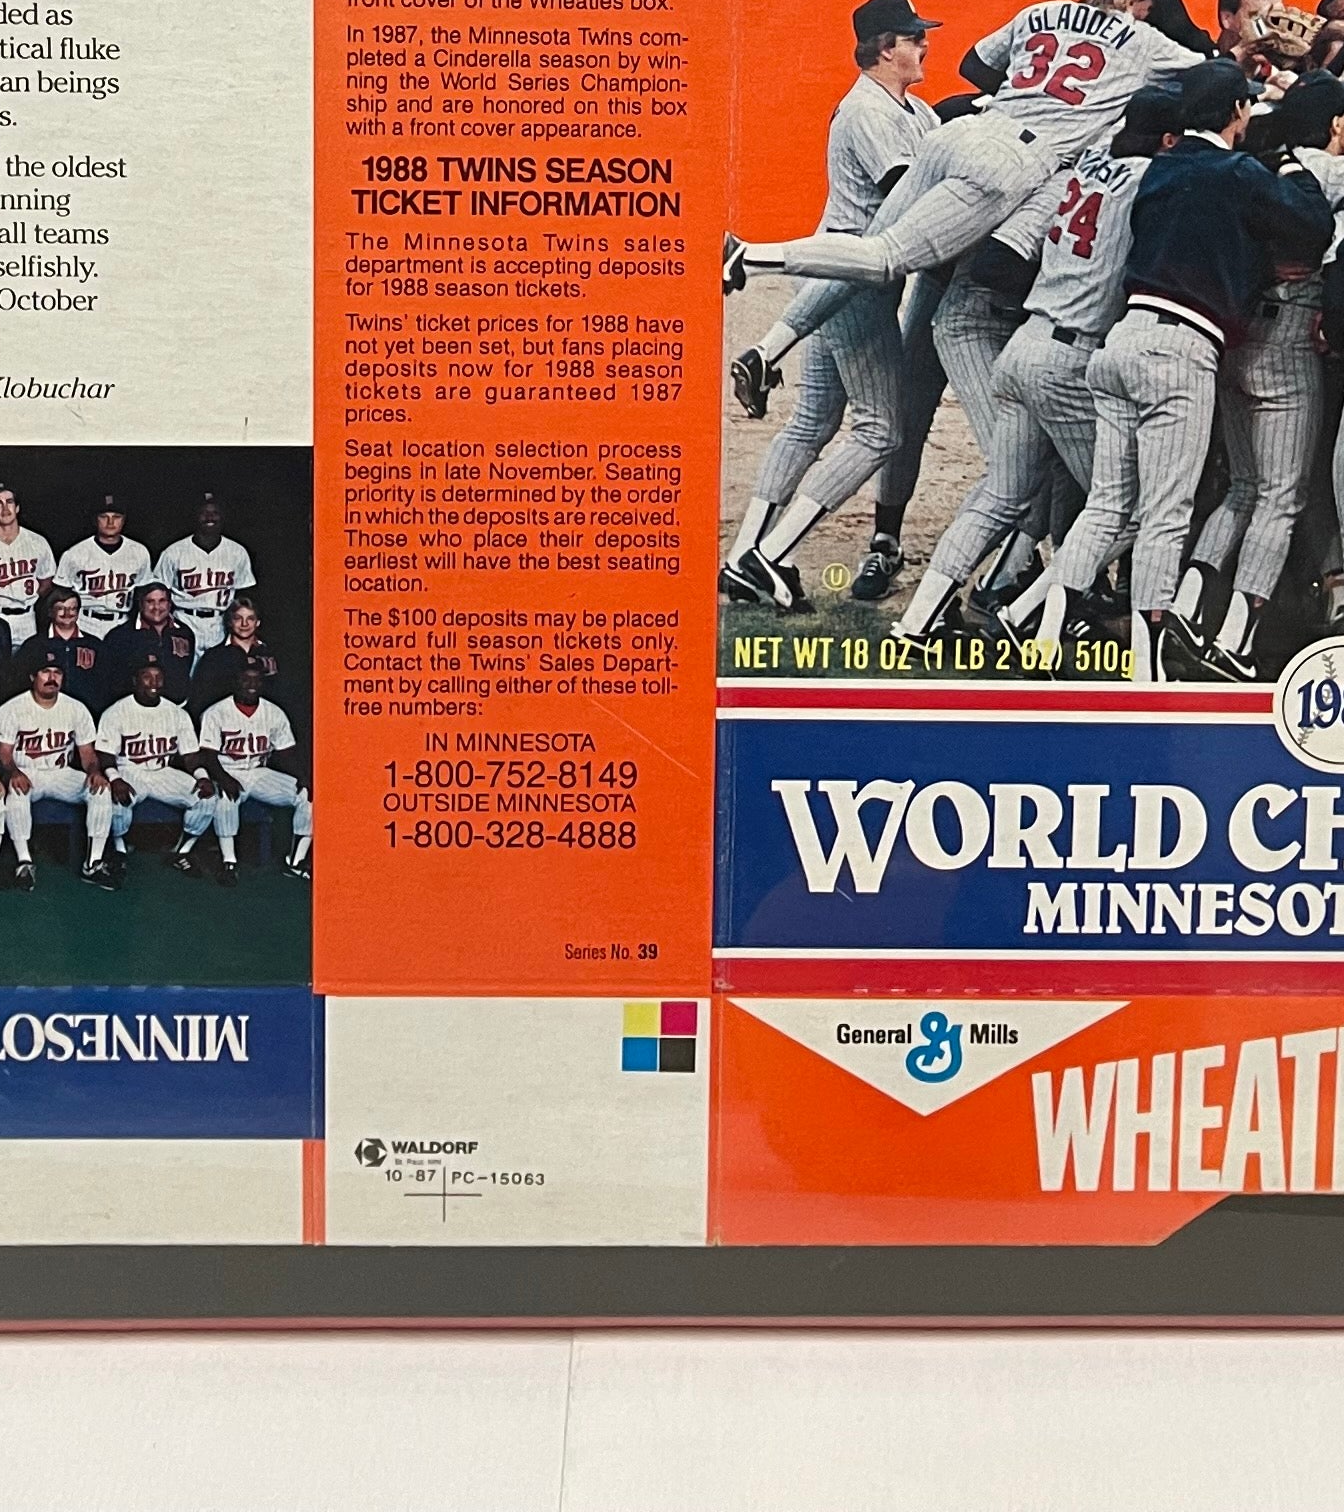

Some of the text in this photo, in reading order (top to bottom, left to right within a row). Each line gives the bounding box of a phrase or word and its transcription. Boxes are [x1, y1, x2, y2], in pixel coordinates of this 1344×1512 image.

[1028, 3, 1136, 50] GLADDEN
[1011, 32, 1106, 106] 32
[361, 156, 672, 185] 1988 TWINS SEASON
[351, 190, 681, 218] TICKET INFORMATION
[734, 637, 782, 669] NET
[793, 637, 831, 669] WT
[841, 637, 868, 670] 18
[880, 638, 910, 670] OZ
[924, 638, 943, 672] (1
[955, 639, 984, 671] LB
[996, 639, 1010, 671] 2
[1076, 640, 1135, 679] 510g
[384, 760, 638, 790] 1-800-752-8149
[384, 820, 637, 850] 1-800-328-4888
[771, 779, 1208, 894] WORLD
[565, 944, 658, 960] Series No. 39
[392, 1141, 479, 1155] WALDORF
[452, 1171, 545, 1186] PC-15063
